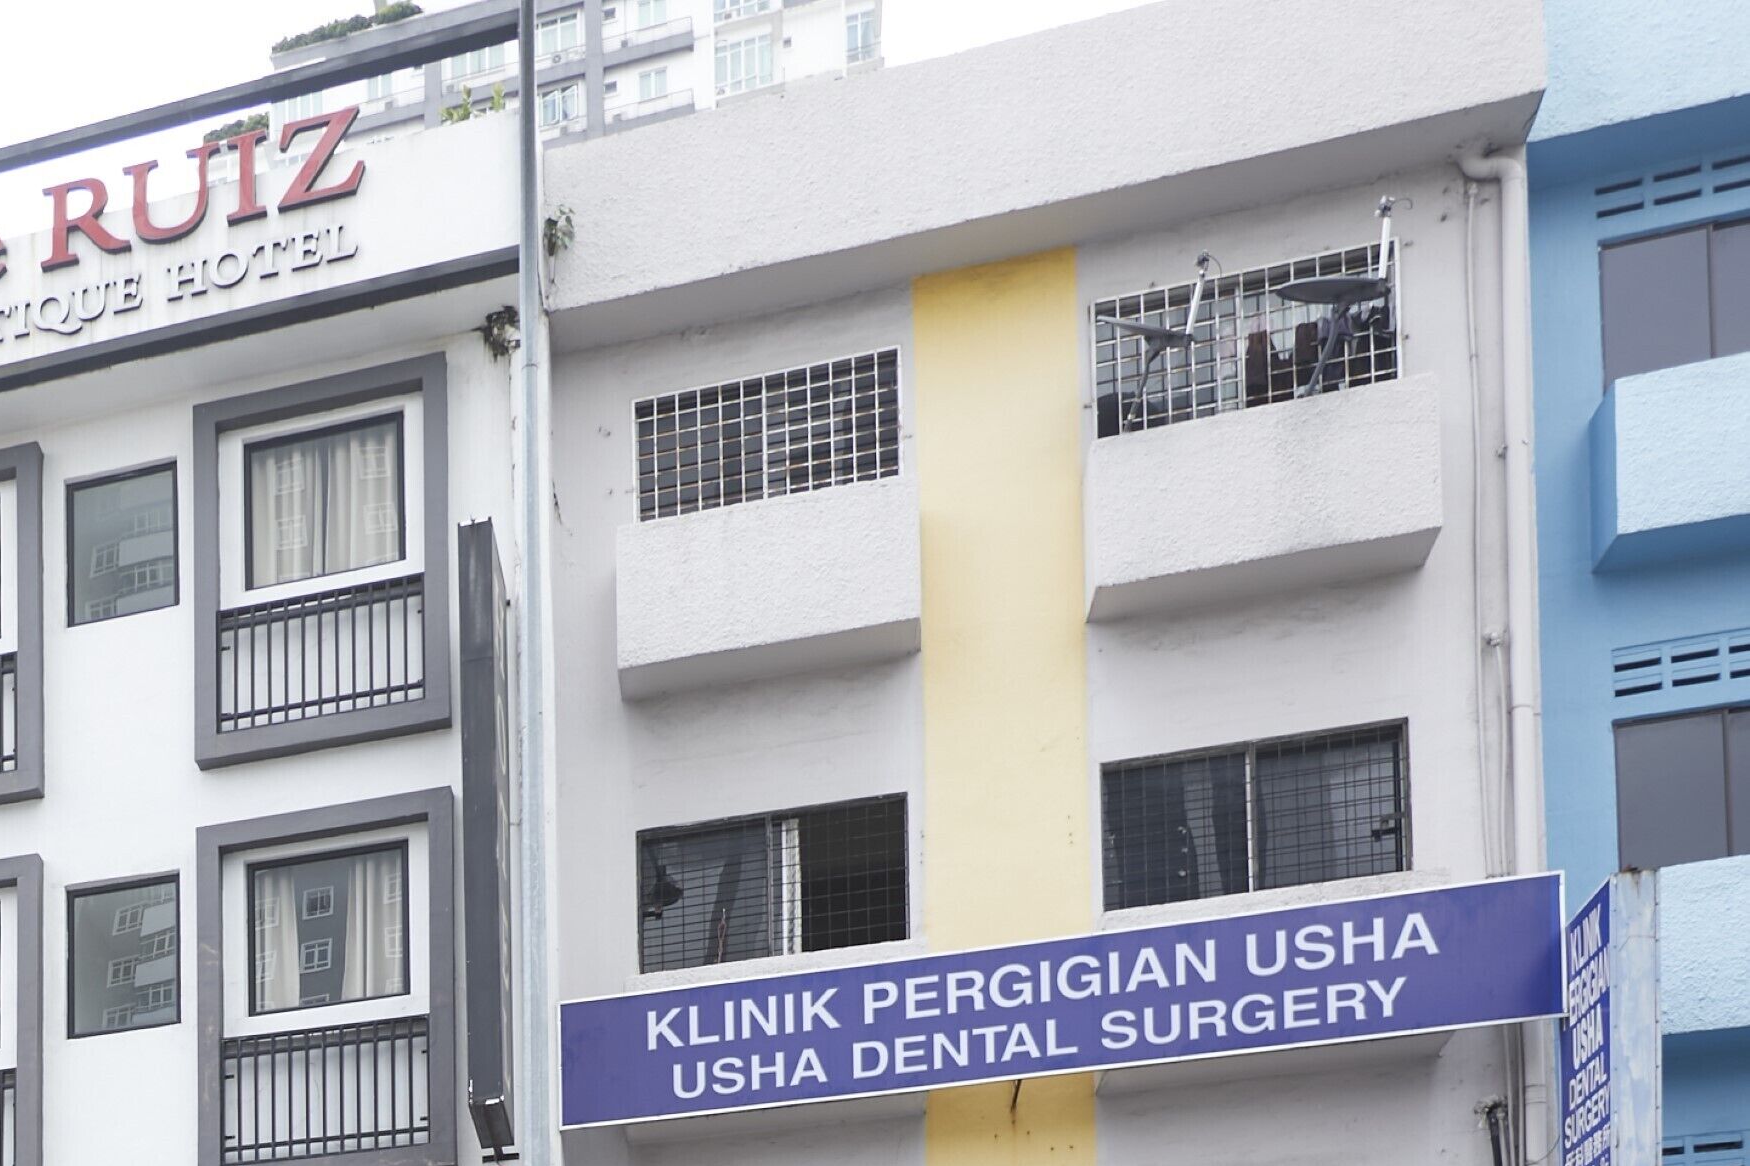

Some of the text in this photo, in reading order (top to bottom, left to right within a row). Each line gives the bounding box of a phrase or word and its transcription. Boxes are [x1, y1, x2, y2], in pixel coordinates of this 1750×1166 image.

[41, 106, 366, 273] RUIZ
[167, 224, 358, 302] HOTEL
[1570, 903, 1601, 975] KLINIK
[646, 912, 1440, 1051] KLINIK PERGIGIAN USHA
[1569, 943, 1610, 1027] ERGIGIAN
[672, 976, 1407, 1099] USHA DENTAL SURGERY
[1572, 1003, 1604, 1070] USHA
[1565, 1081, 1610, 1149] SURGERY
[1569, 1052, 1607, 1110] DENTAL
